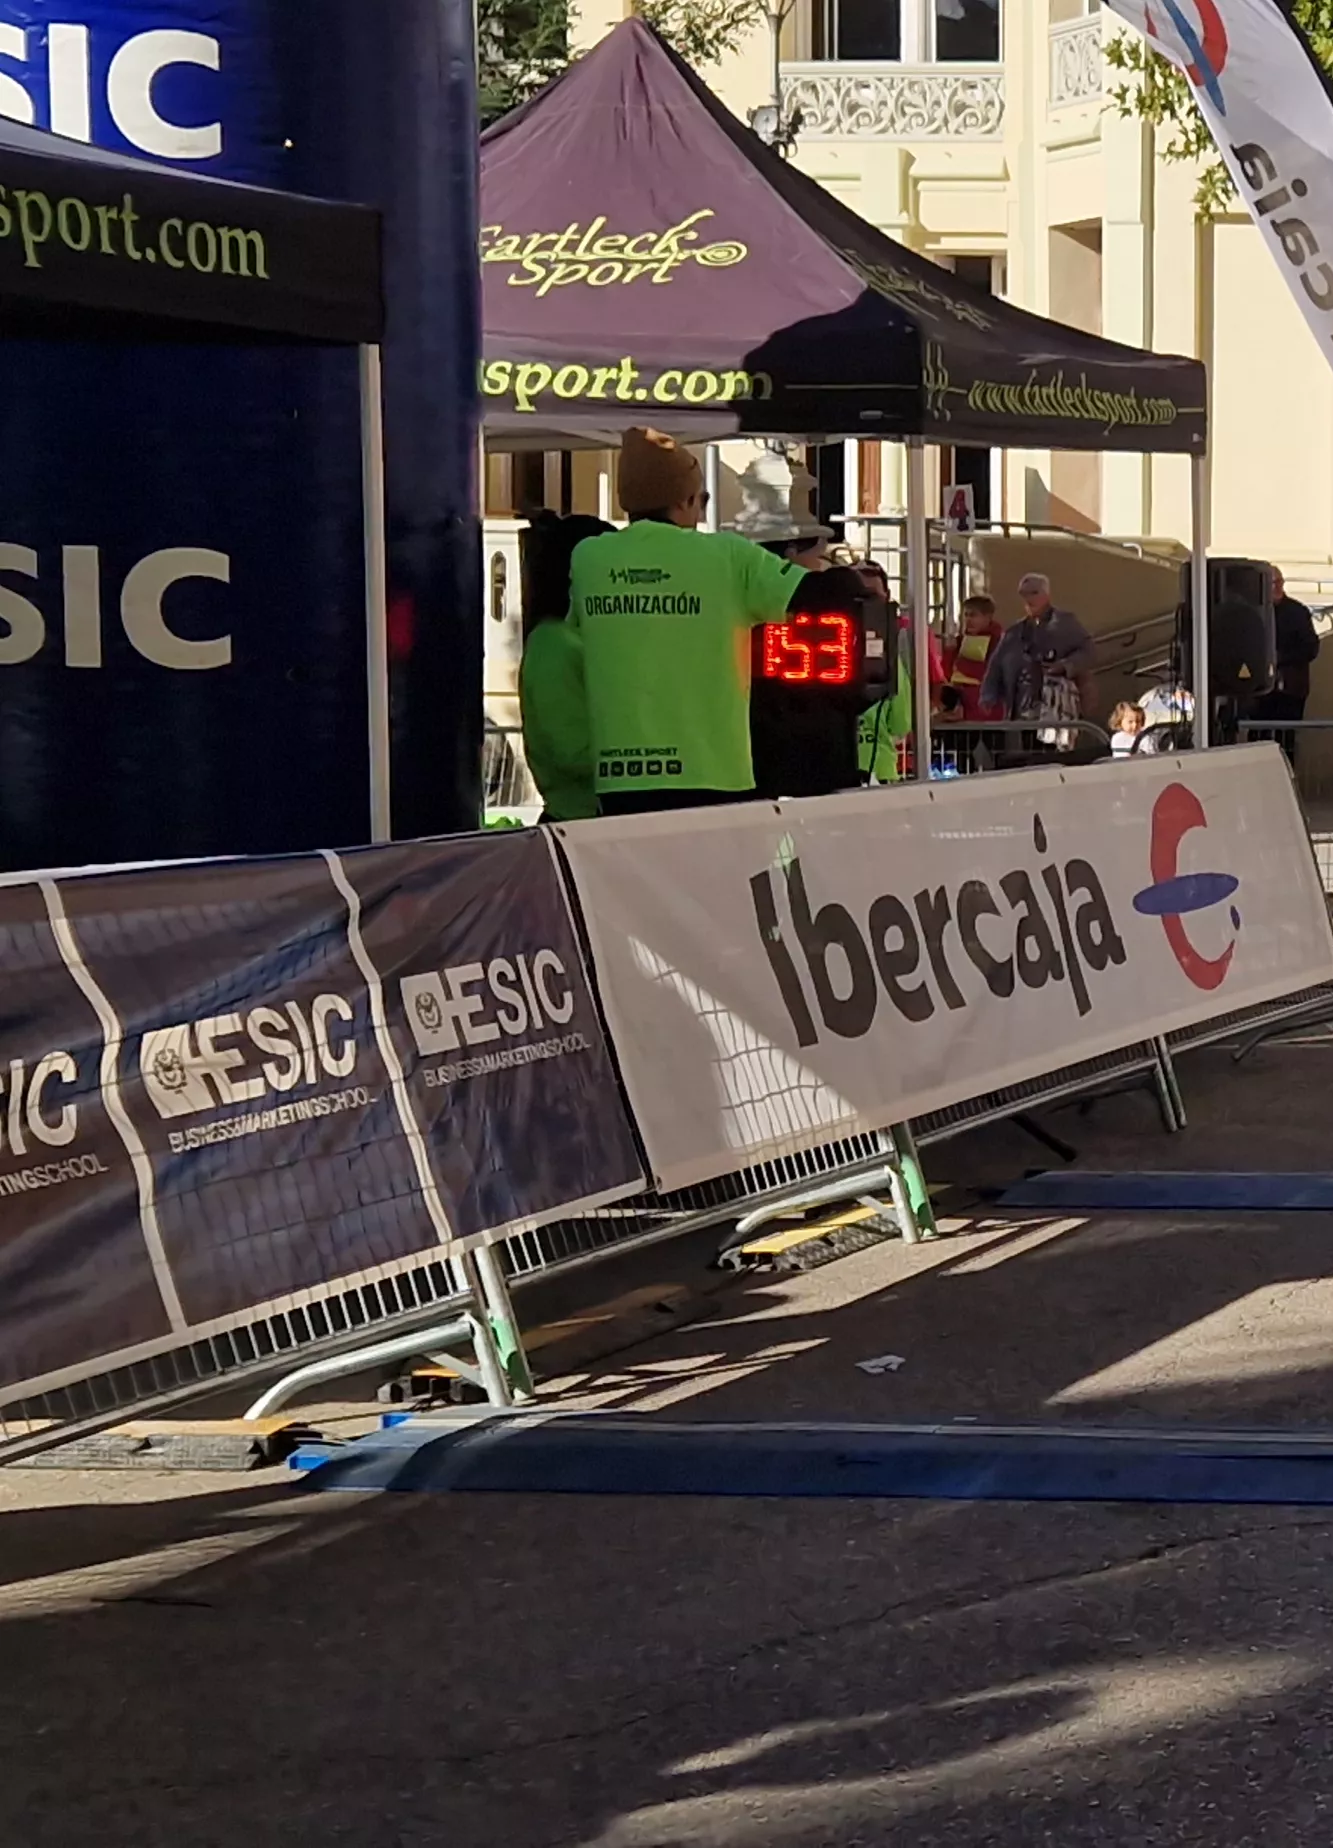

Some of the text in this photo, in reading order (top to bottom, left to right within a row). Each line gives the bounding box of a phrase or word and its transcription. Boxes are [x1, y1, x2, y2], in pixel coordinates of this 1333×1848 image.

[507, 250, 682, 298] Sport
[585, 591, 701, 617] ORGANIZACIÓN
[748, 812, 1128, 1048] Ibercaja
[442, 948, 574, 1046] ESIC
[190, 993, 357, 1105] ESIC
